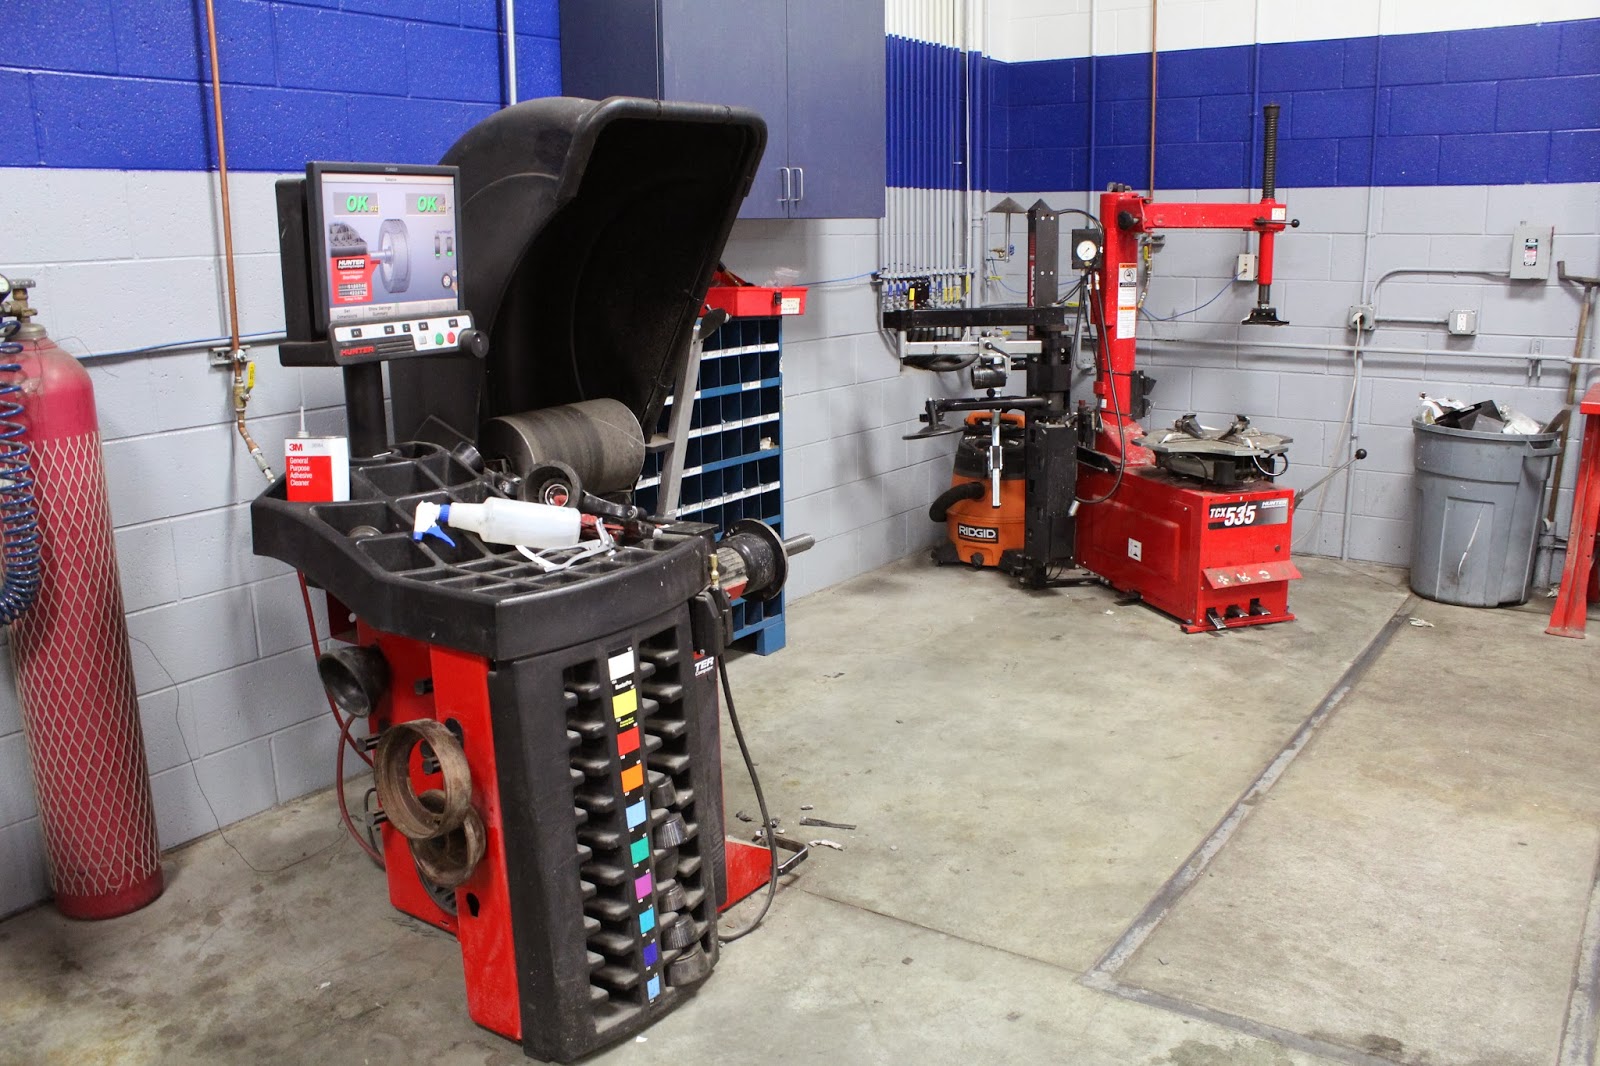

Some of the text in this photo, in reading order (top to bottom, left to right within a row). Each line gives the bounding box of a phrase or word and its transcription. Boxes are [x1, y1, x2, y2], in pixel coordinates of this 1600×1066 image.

[346, 195, 368, 212] OK
[417, 196, 437, 212] OK
[341, 346, 374, 356] HUNTER
[289, 444, 302, 452] 3M
[958, 525, 996, 538] RIDGID
